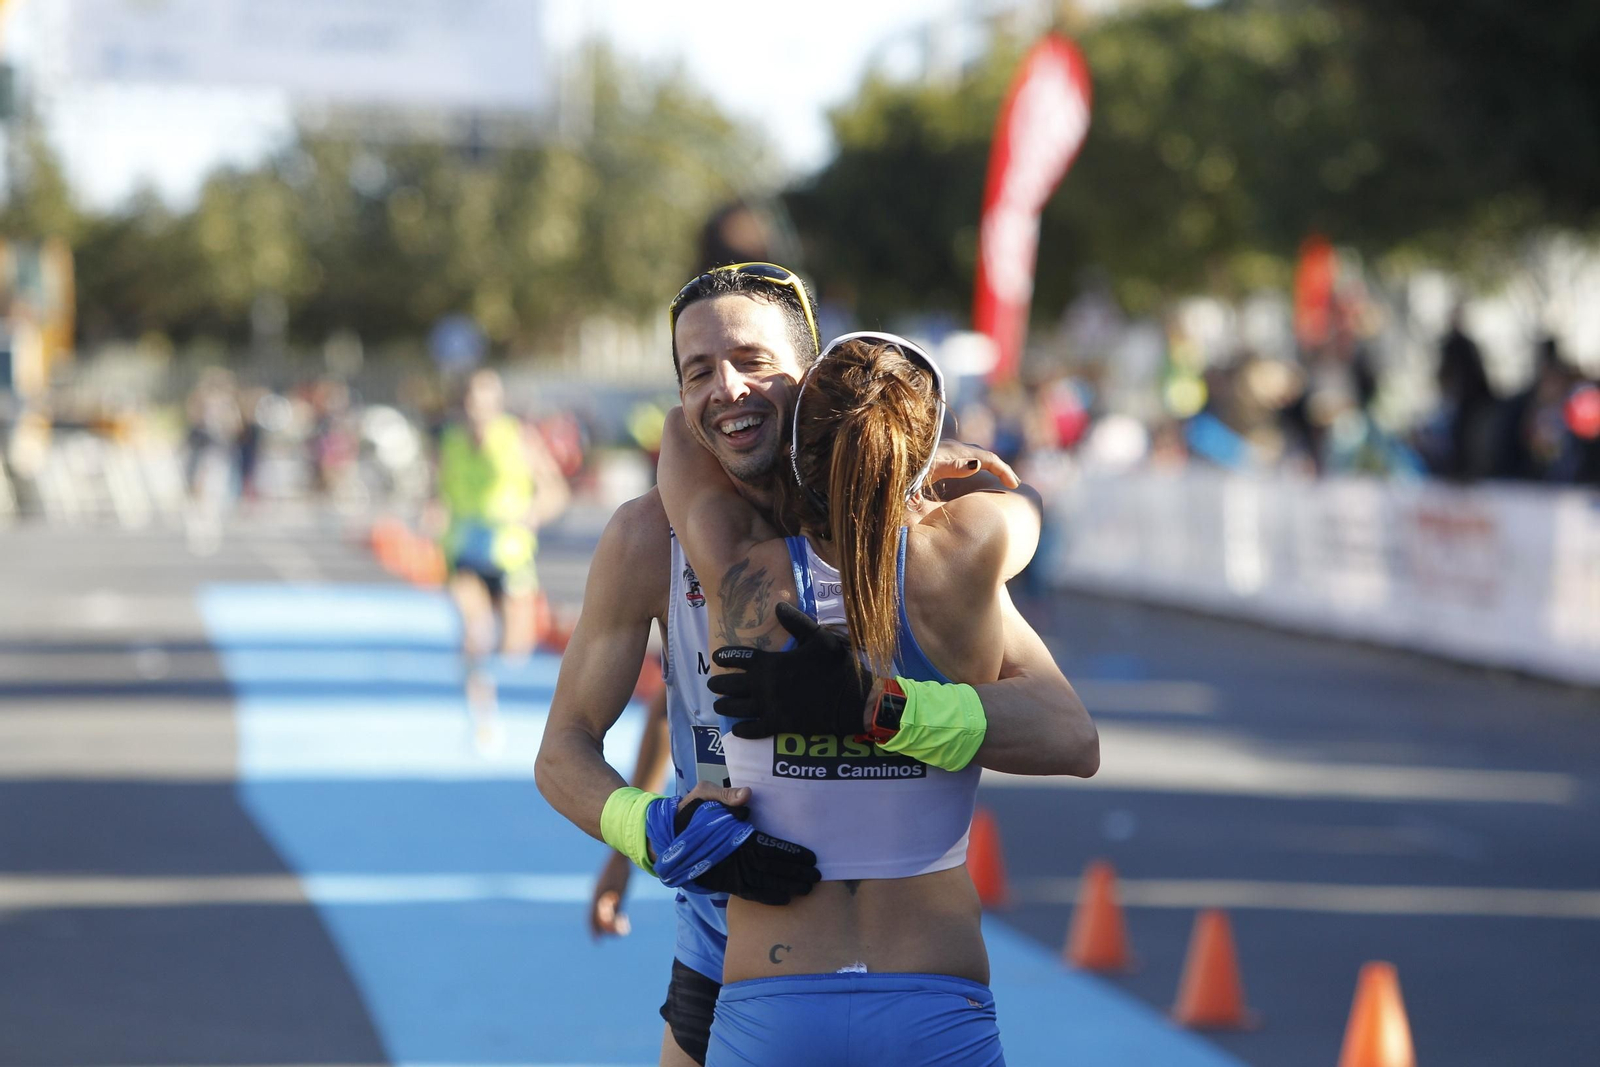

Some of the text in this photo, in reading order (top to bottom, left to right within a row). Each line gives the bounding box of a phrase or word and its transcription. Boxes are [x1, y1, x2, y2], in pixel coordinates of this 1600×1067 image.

[776, 733, 901, 757] bas
[775, 761, 923, 778] Corre Caminos
